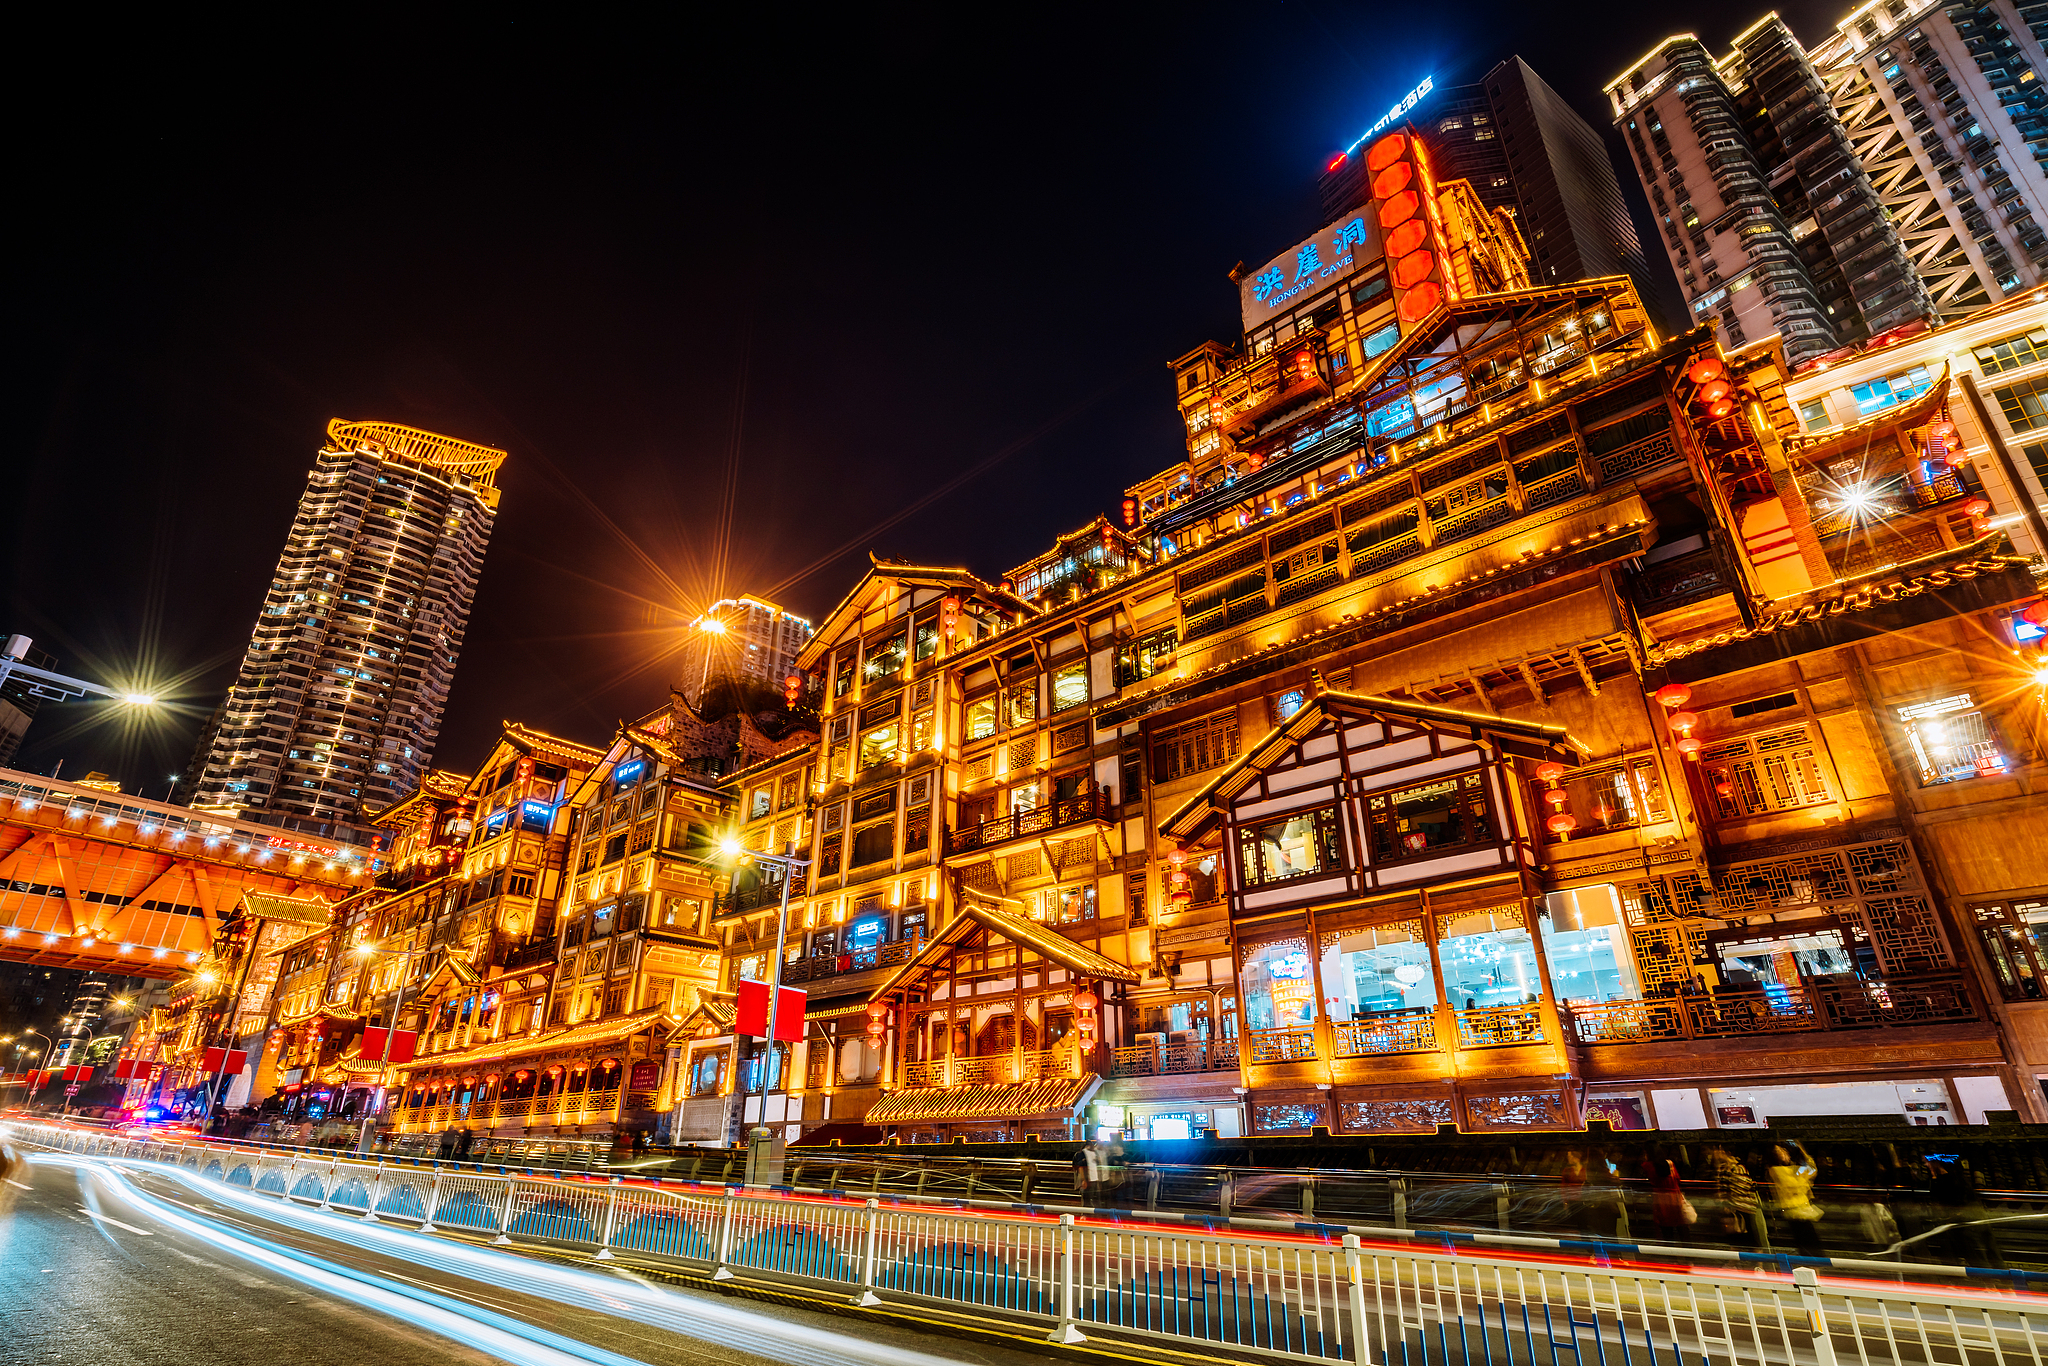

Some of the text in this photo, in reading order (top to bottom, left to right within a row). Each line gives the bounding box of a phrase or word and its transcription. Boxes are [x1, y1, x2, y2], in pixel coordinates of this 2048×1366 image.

[1253, 218, 1366, 301] 洪崖洞
[1269, 254, 1353, 308] HONGYA CAVE
